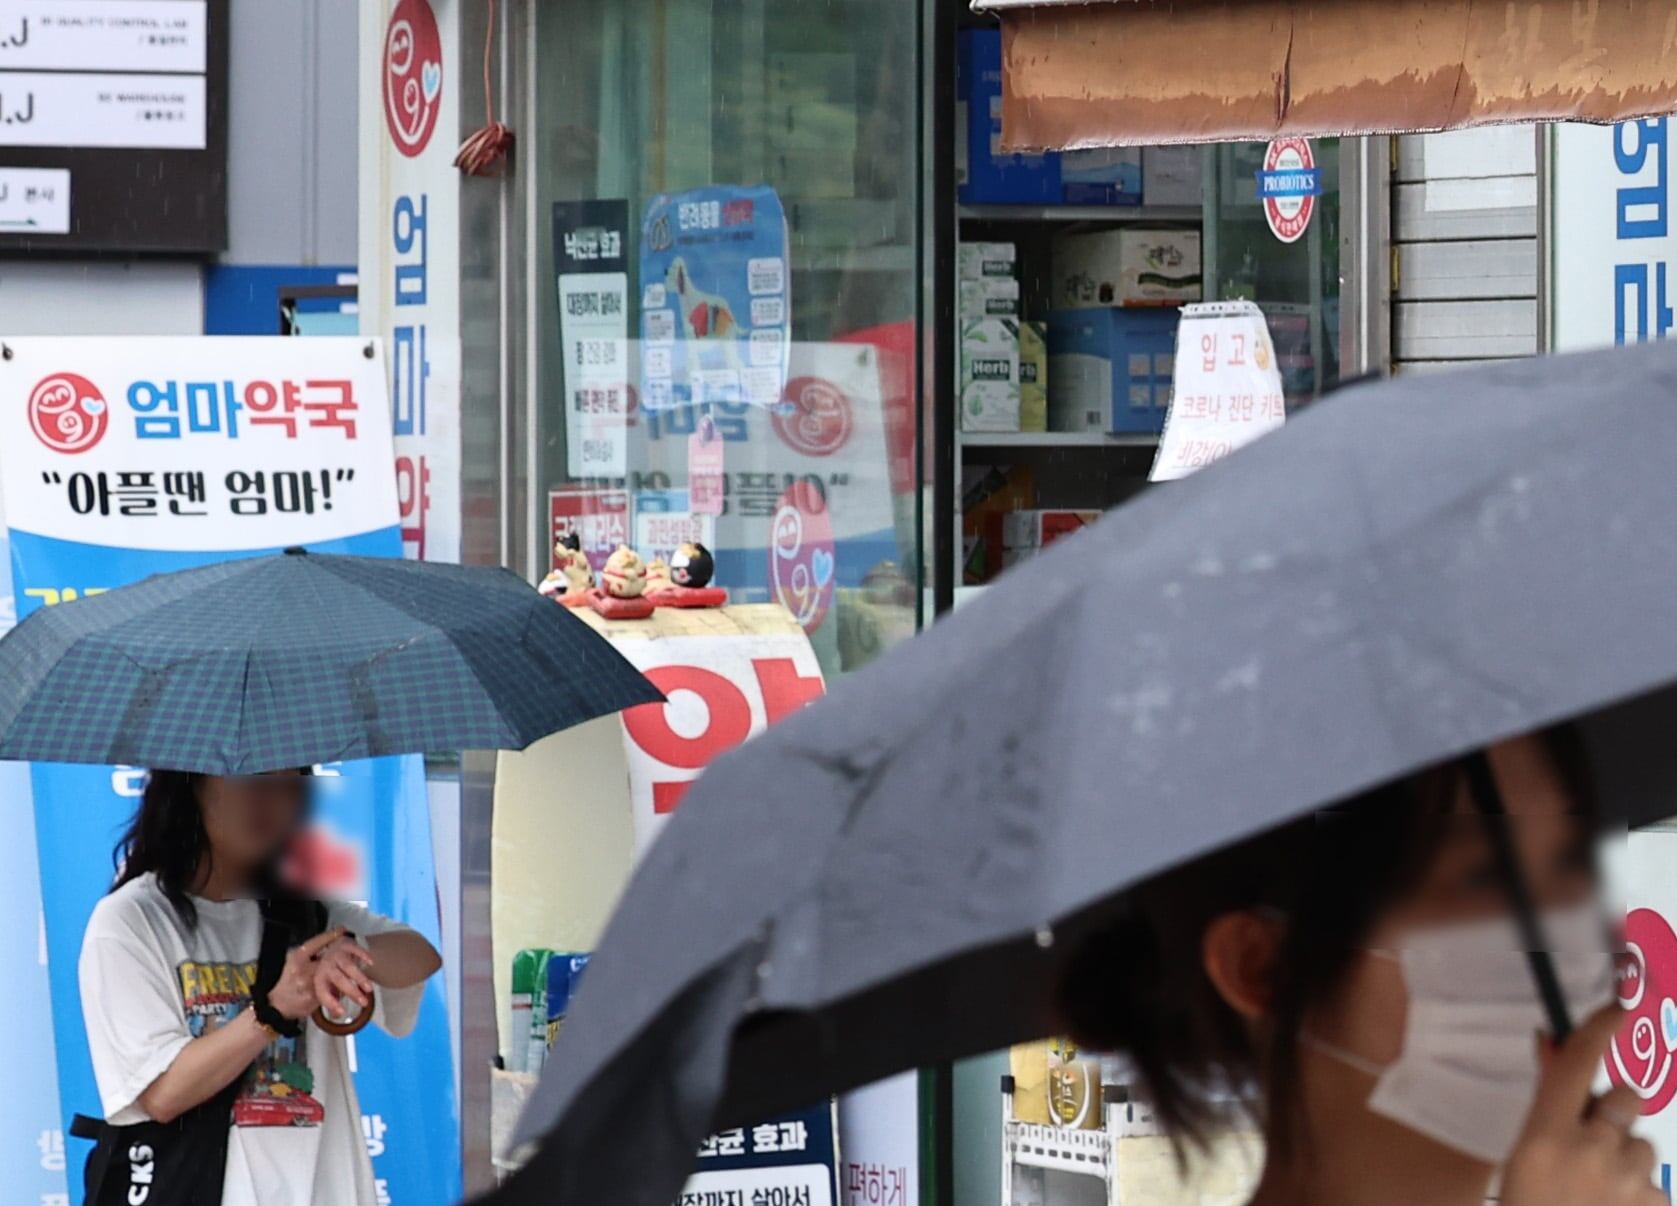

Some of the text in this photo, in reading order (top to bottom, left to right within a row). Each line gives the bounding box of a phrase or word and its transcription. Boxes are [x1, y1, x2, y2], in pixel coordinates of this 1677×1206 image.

[1264, 175, 1315, 191] PROBIOTICS
[1227, 334, 1245, 365] 고
[973, 359, 1009, 375] Herb
[126, 379, 358, 439] 엄마약국
[752, 1120, 808, 1153] 효과
